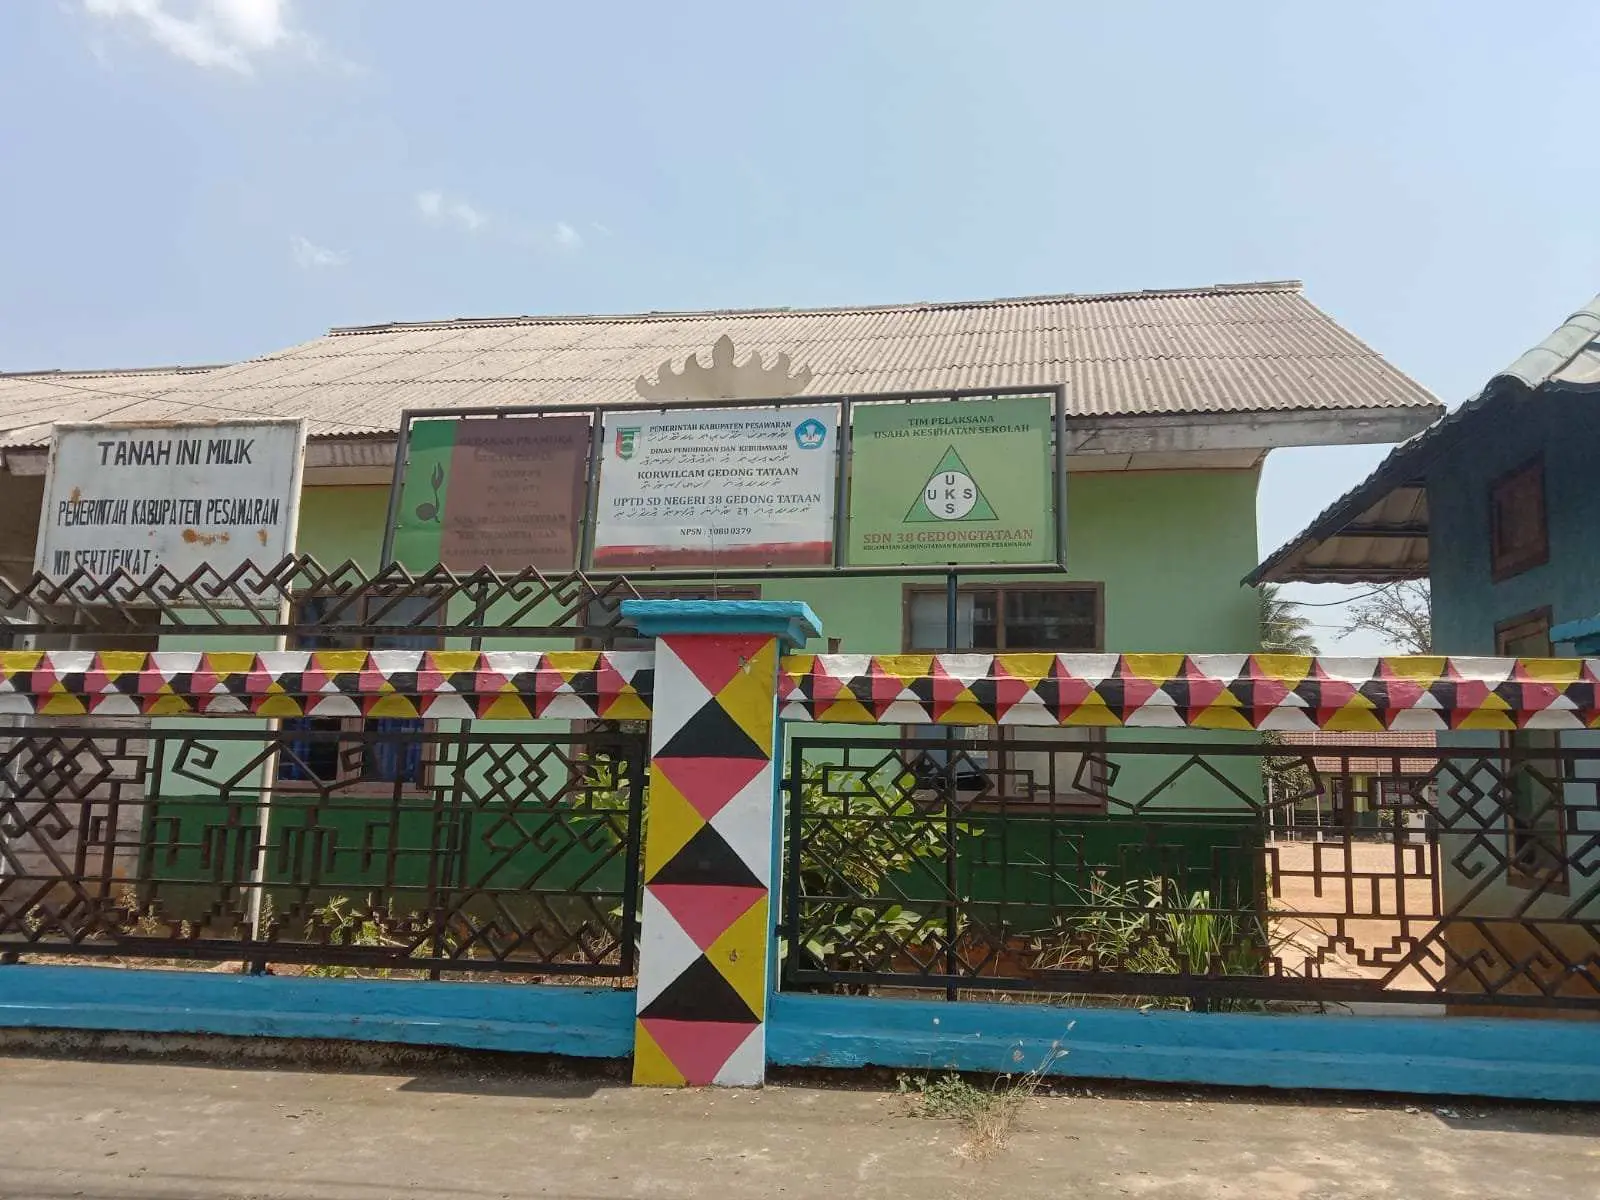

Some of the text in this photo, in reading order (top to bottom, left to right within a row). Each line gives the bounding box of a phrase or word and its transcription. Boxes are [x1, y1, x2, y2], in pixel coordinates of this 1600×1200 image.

[649, 420, 792, 432] PEMERINTAH KABUPATEN PESAWARAN
[908, 415, 995, 426] TIM PELAKSANA
[874, 430, 910, 439] USAHA
[978, 424, 1030, 434] SEKOLAH
[98, 438, 255, 466] TANAH INI MILIK
[650, 447, 672, 455] DINAS
[637, 467, 799, 479] KORWILCAM GEDONG TATAAN
[613, 493, 821, 507] UPTD SD NEGERI 38 GEDONG TATAAN
[57, 499, 127, 526] PEMERINTAH
[131, 498, 200, 526] KABUPATEN
[680, 527, 702, 536] NPSN
[863, 529, 1033, 544] SDN 38 GEDONGTATAAN
